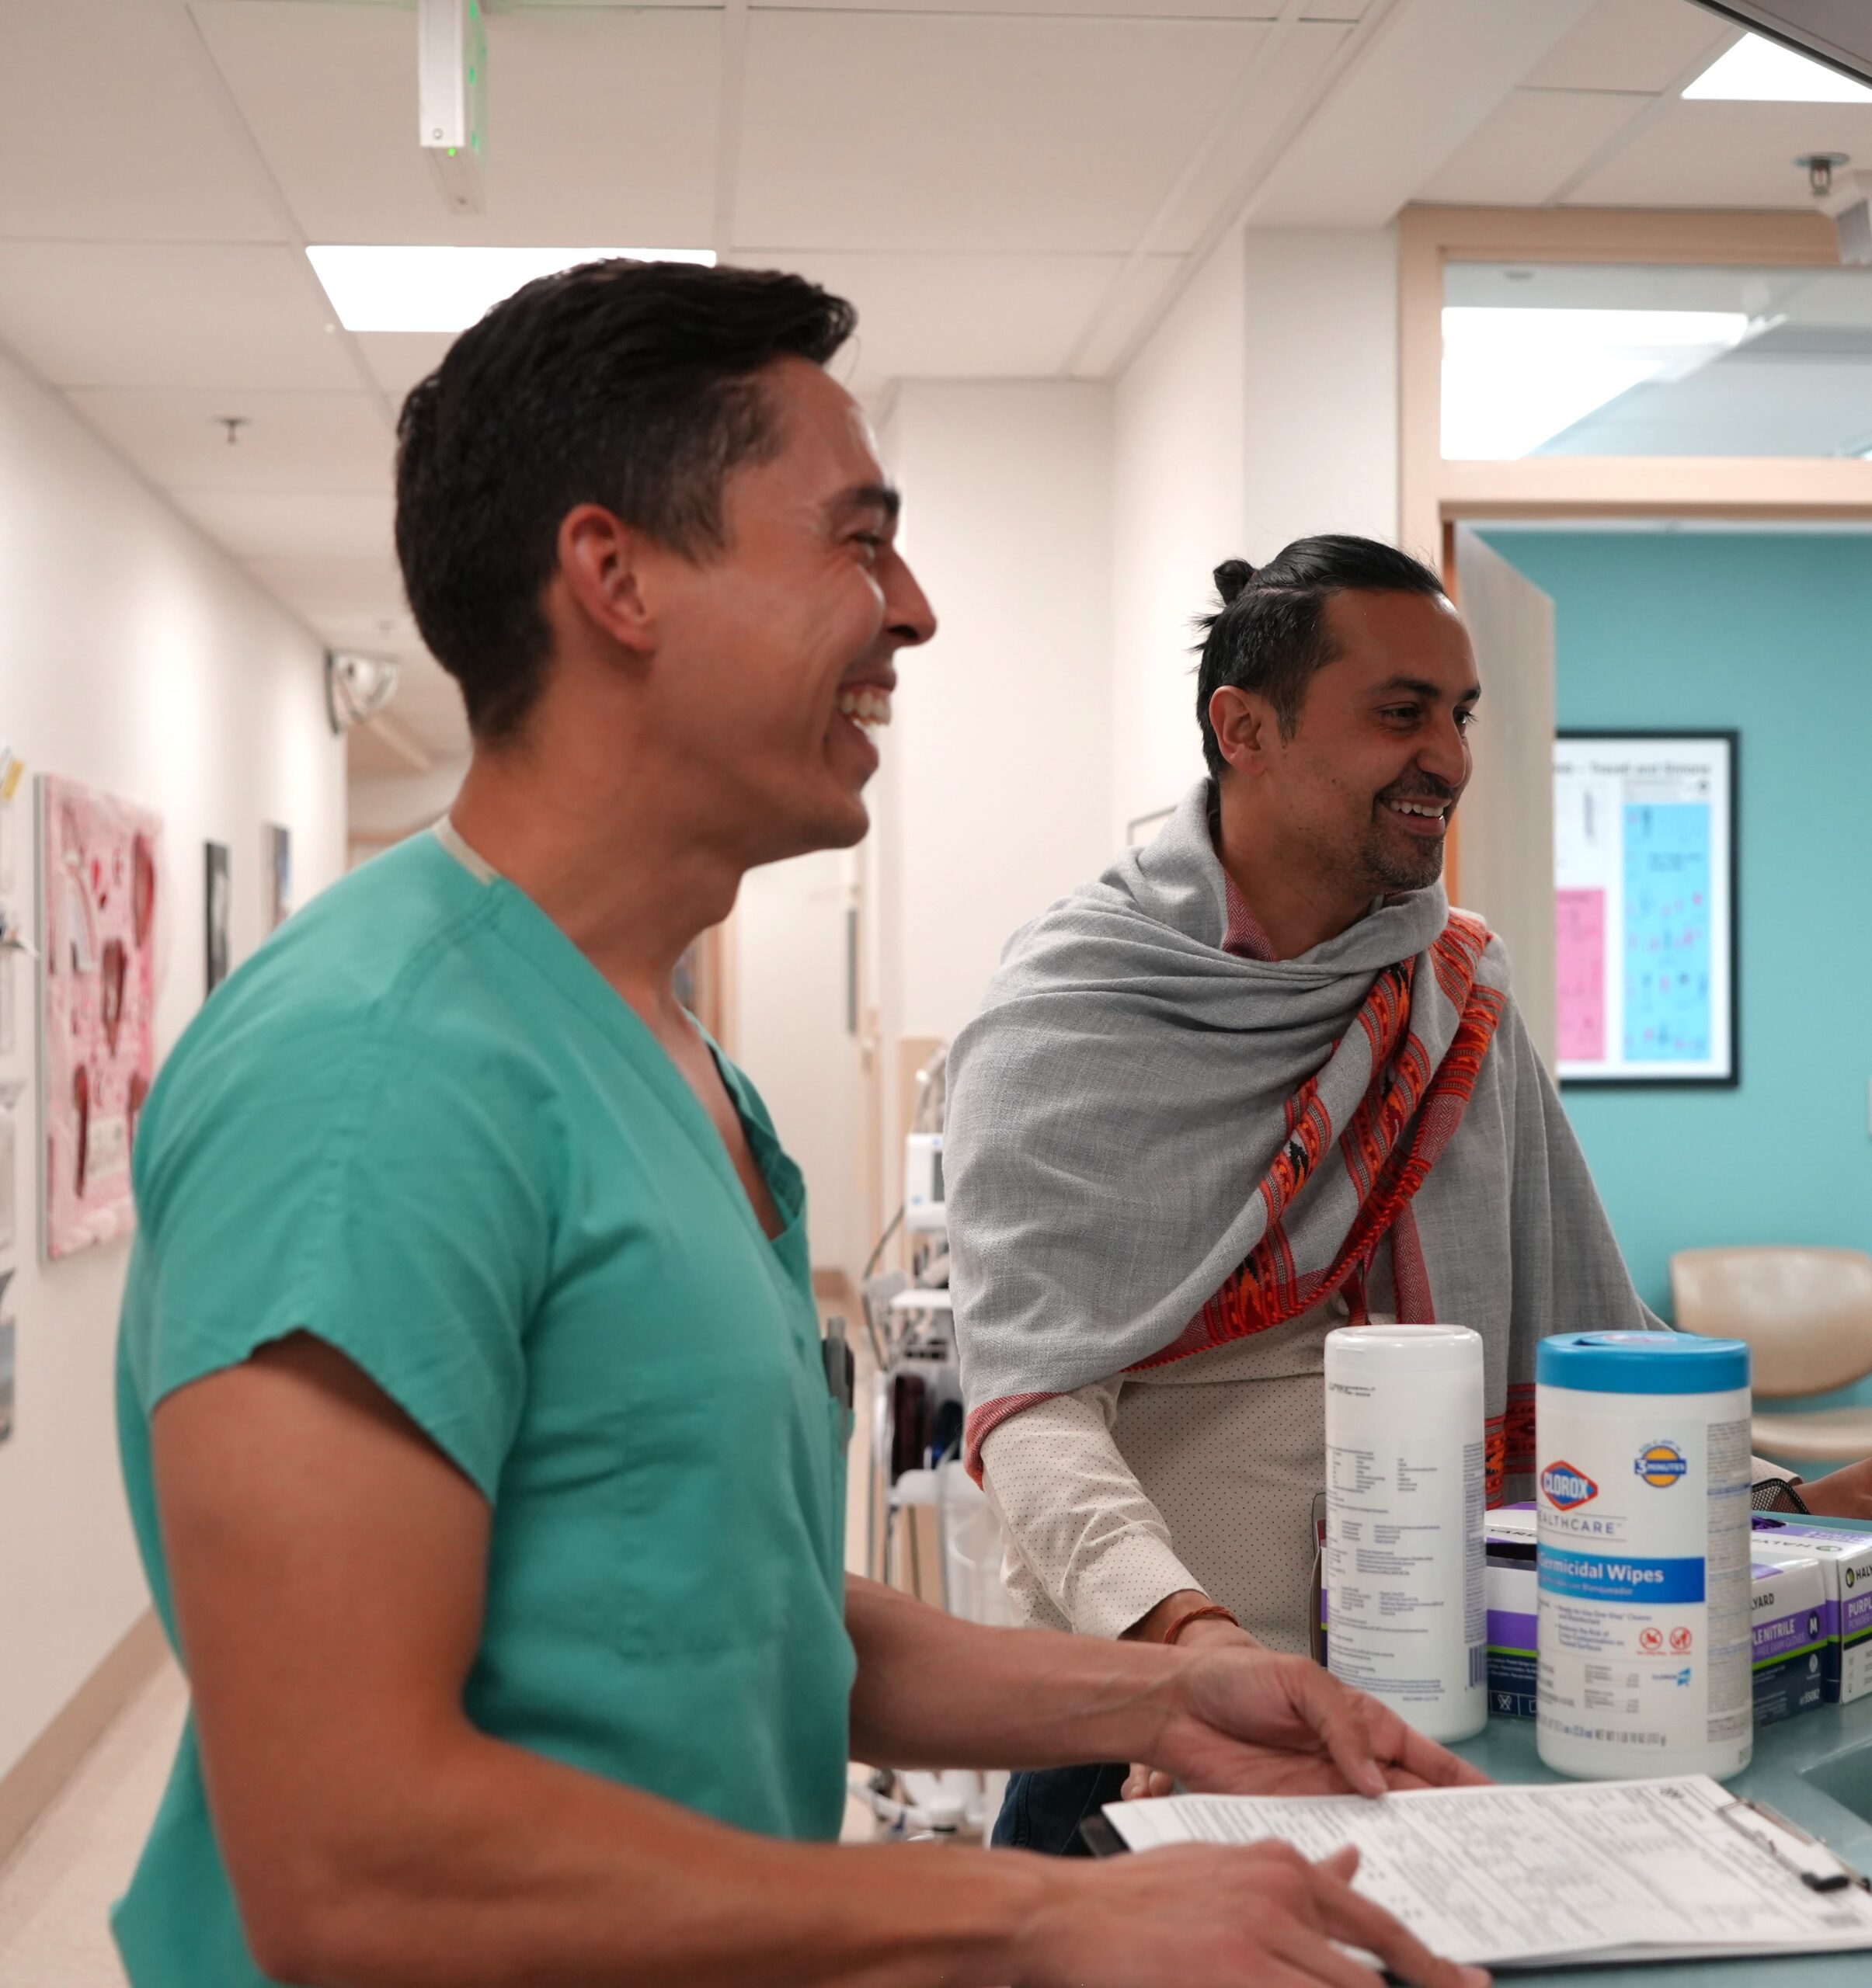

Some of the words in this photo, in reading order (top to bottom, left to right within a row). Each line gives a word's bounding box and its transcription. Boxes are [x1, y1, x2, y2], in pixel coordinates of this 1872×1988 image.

[1635, 1458, 1647, 1474] 3
[1543, 1472, 1588, 1499] CLOROX
[1538, 1510, 1615, 1534] EALTHCARE
[1606, 1564, 1665, 1585] Wipes
[1856, 1566, 1872, 1581] HALY
[1752, 1593, 1775, 1610] YARD
[1848, 1596, 1872, 1618] PURPL
[1763, 1618, 1795, 1642] NITRILE
[1809, 1617, 1818, 1634] M
